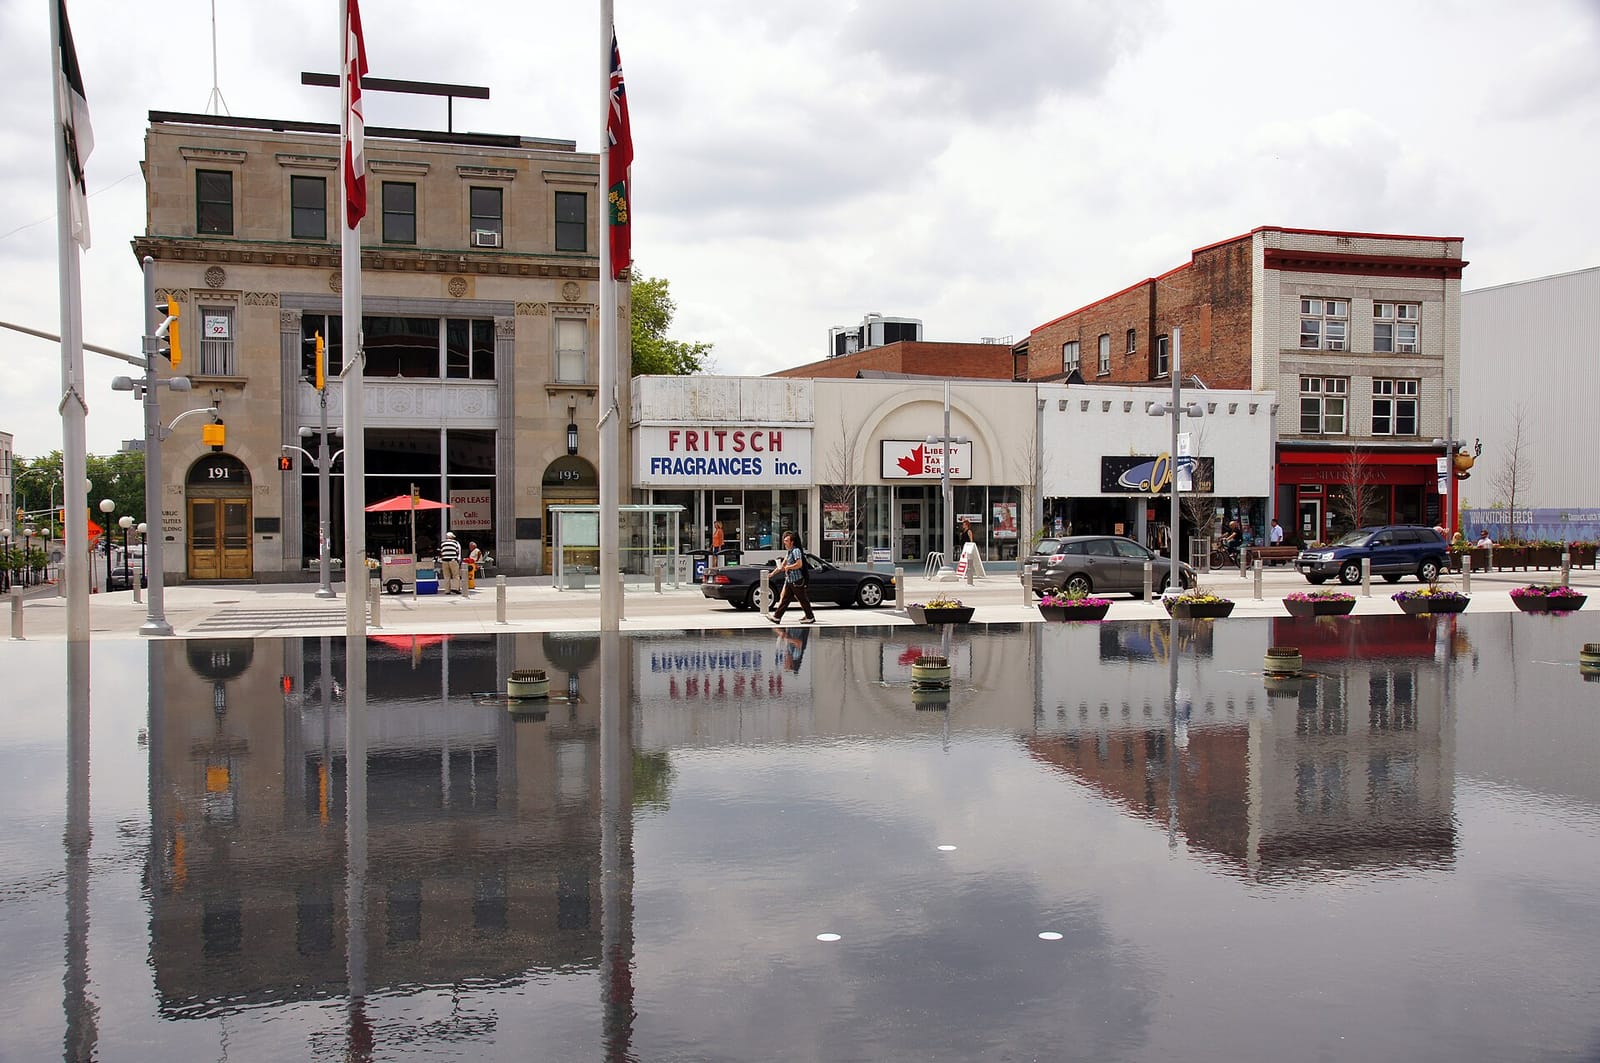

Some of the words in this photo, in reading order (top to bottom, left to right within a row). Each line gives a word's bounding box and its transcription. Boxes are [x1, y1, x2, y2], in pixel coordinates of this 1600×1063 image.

[669, 431, 782, 452] FRITSCH
[924, 446, 959, 455] LIBETY
[924, 456, 941, 464] TAX
[650, 457, 762, 475] FRAGRANCES
[775, 458, 802, 475] inc.
[924, 465, 961, 474] SERCE
[207, 467, 229, 479] 191
[559, 471, 580, 480] 195
[451, 496, 466, 504] FOR
[467, 496, 490, 504] LEASE
[1470, 511, 1533, 524] WWW.KITCHEER.CA
